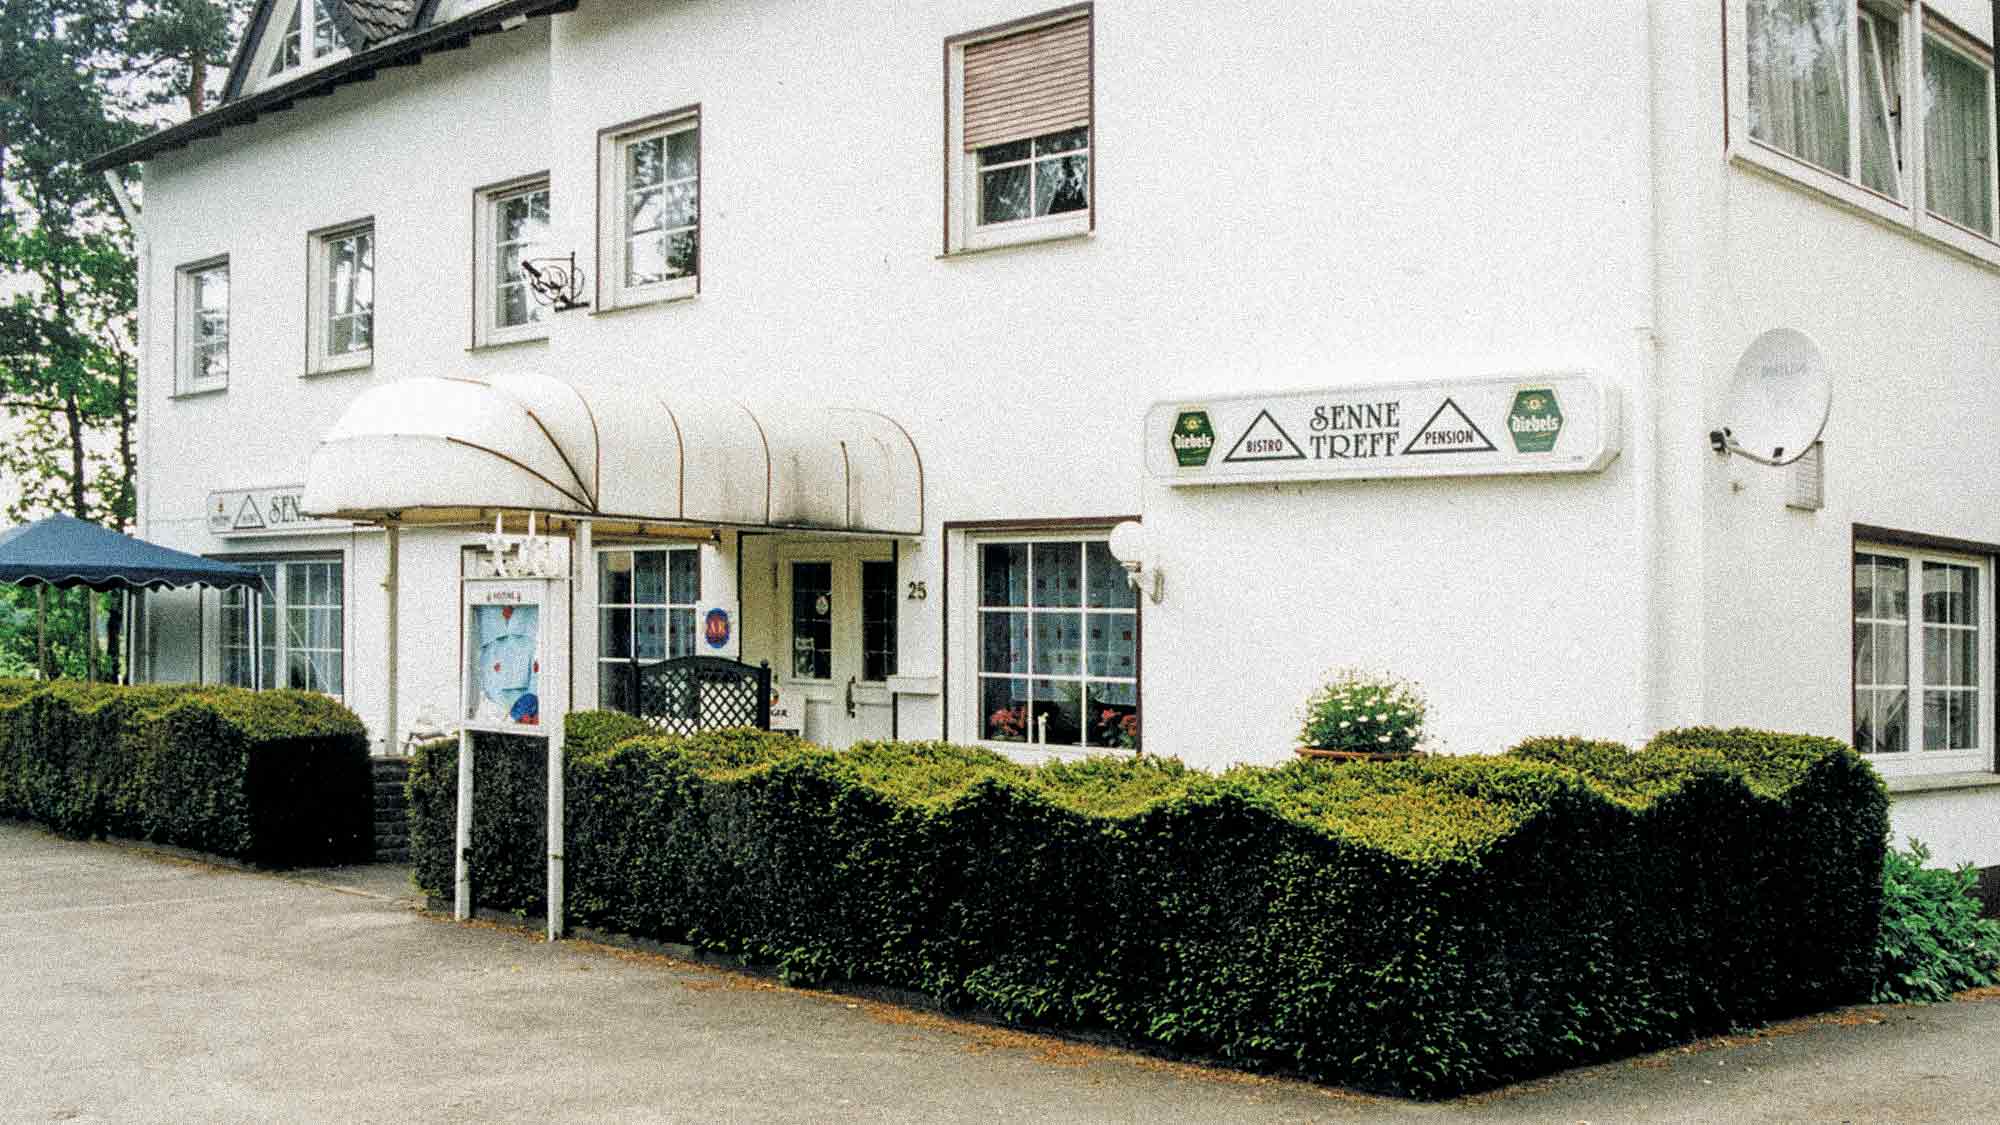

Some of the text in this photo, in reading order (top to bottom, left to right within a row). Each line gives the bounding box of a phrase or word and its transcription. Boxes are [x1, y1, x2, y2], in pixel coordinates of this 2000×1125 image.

[1309, 401, 1400, 431] SENNE
[1246, 438, 1283, 453] BISTRO
[1309, 431, 1400, 459] TREFF
[1424, 430, 1474, 445] PENSION
[908, 581, 927, 600] 25
